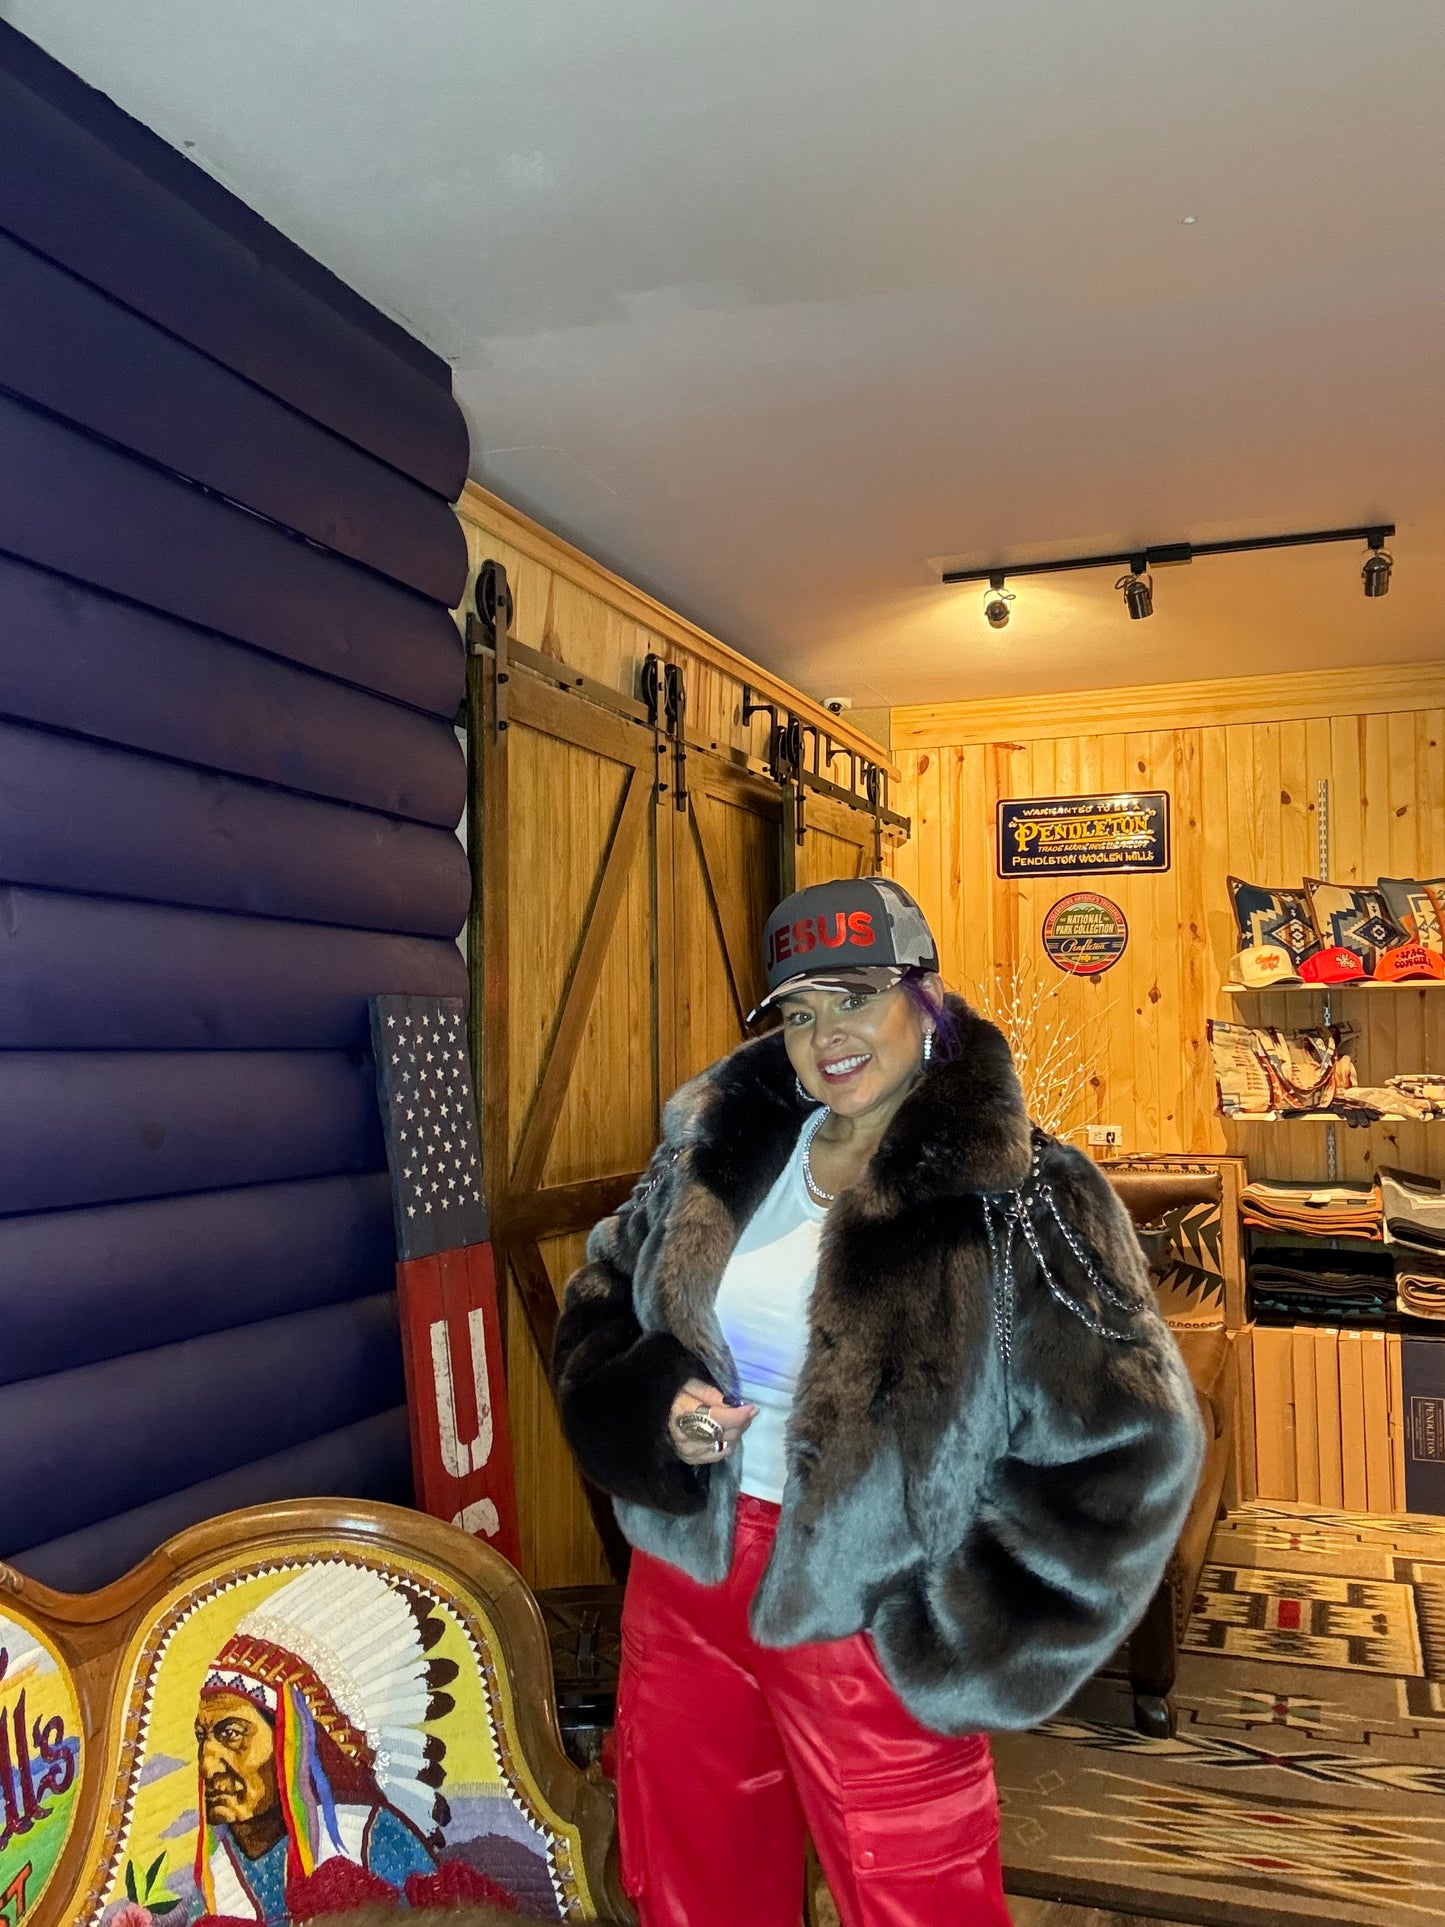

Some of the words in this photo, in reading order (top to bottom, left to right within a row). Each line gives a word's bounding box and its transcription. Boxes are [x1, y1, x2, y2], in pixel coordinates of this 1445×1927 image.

[1012, 854, 1077, 867] PENDLETON
[1079, 852, 1123, 865] WOOLEN
[1125, 850, 1155, 863] MILLS
[1066, 913, 1103, 925] NATIONAL
[1056, 925, 1073, 935] PARK
[1073, 923, 1115, 935] COLLECTION
[767, 910, 876, 971] JESUS
[1424, 1402, 1436, 1455] PENDLETON
